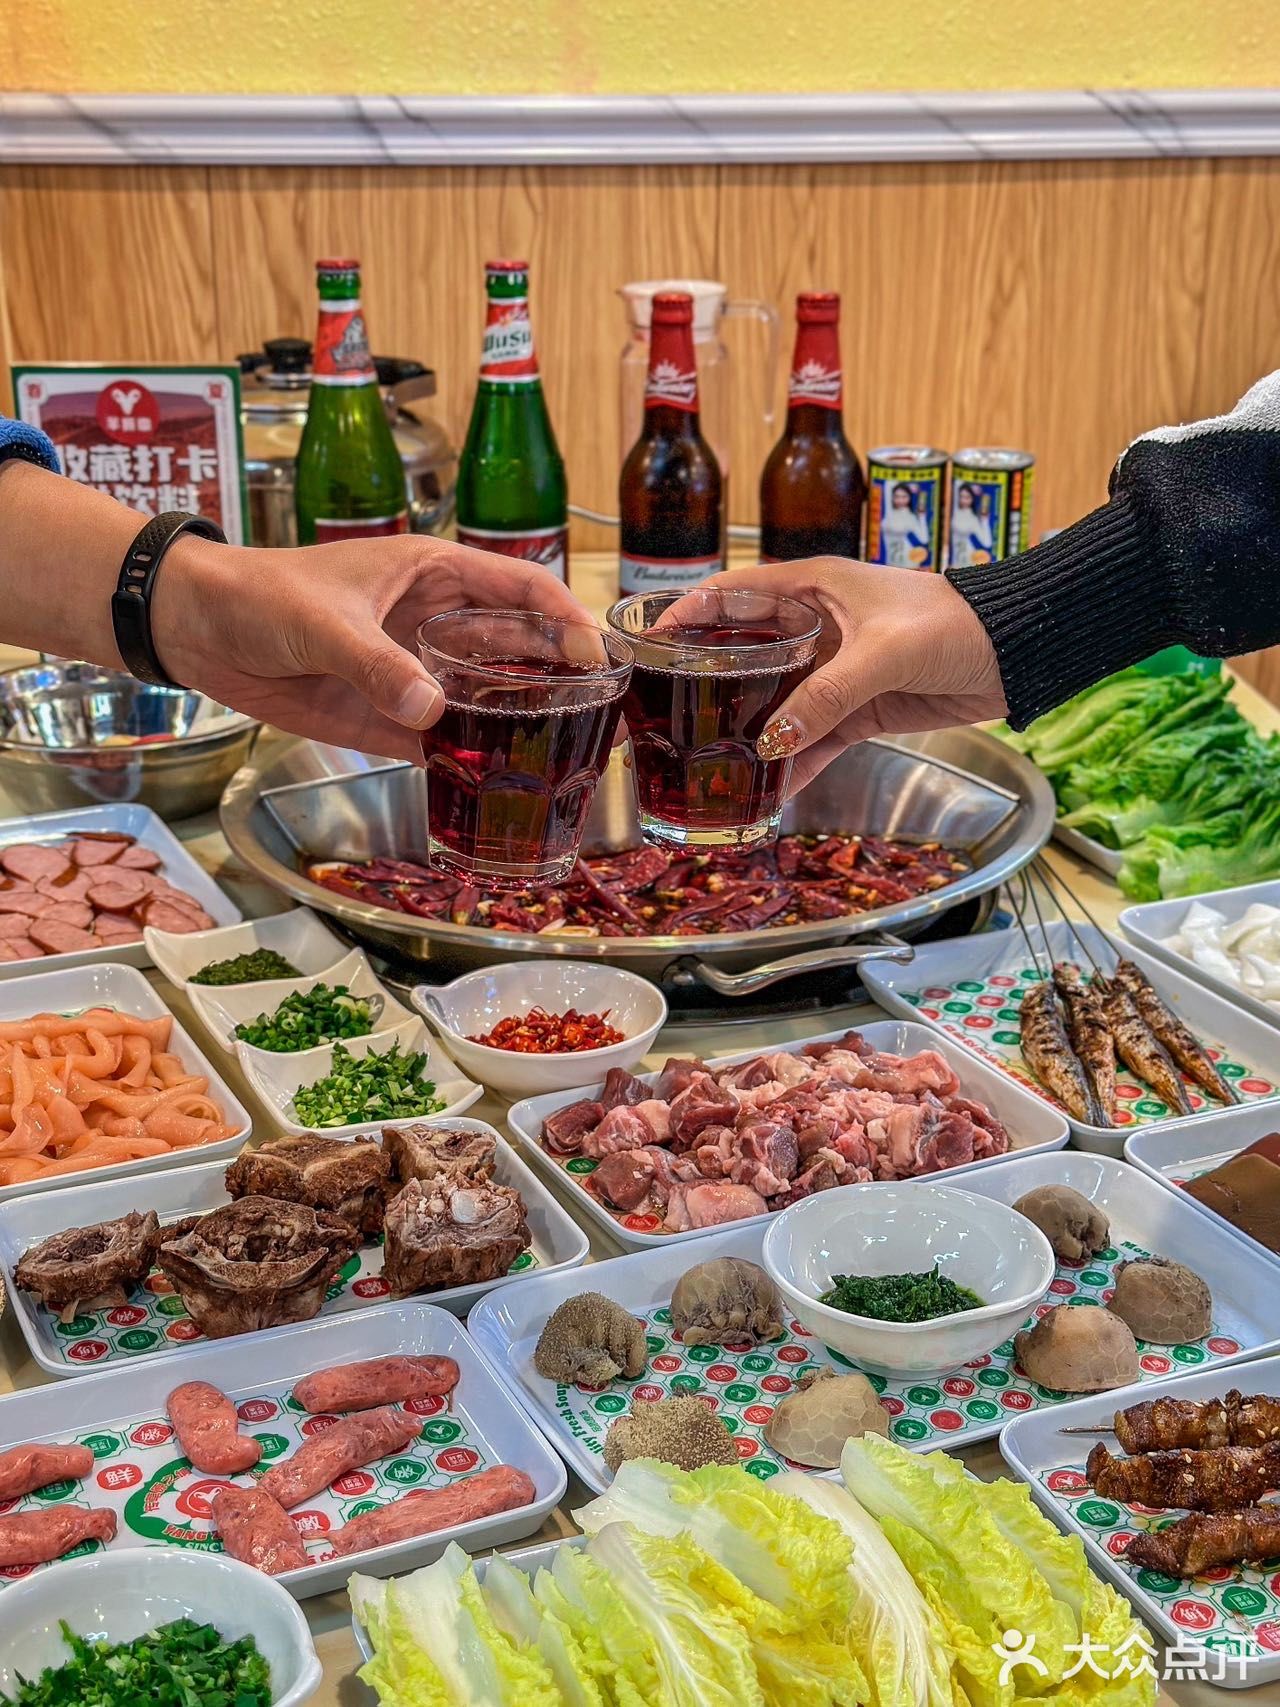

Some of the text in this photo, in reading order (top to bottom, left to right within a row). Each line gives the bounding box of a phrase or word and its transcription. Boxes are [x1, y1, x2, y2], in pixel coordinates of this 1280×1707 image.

[105, 1466, 135, 1487] 鲜
[162, 1524, 208, 1541] YANG
[185, 1541, 224, 1552] SINC
